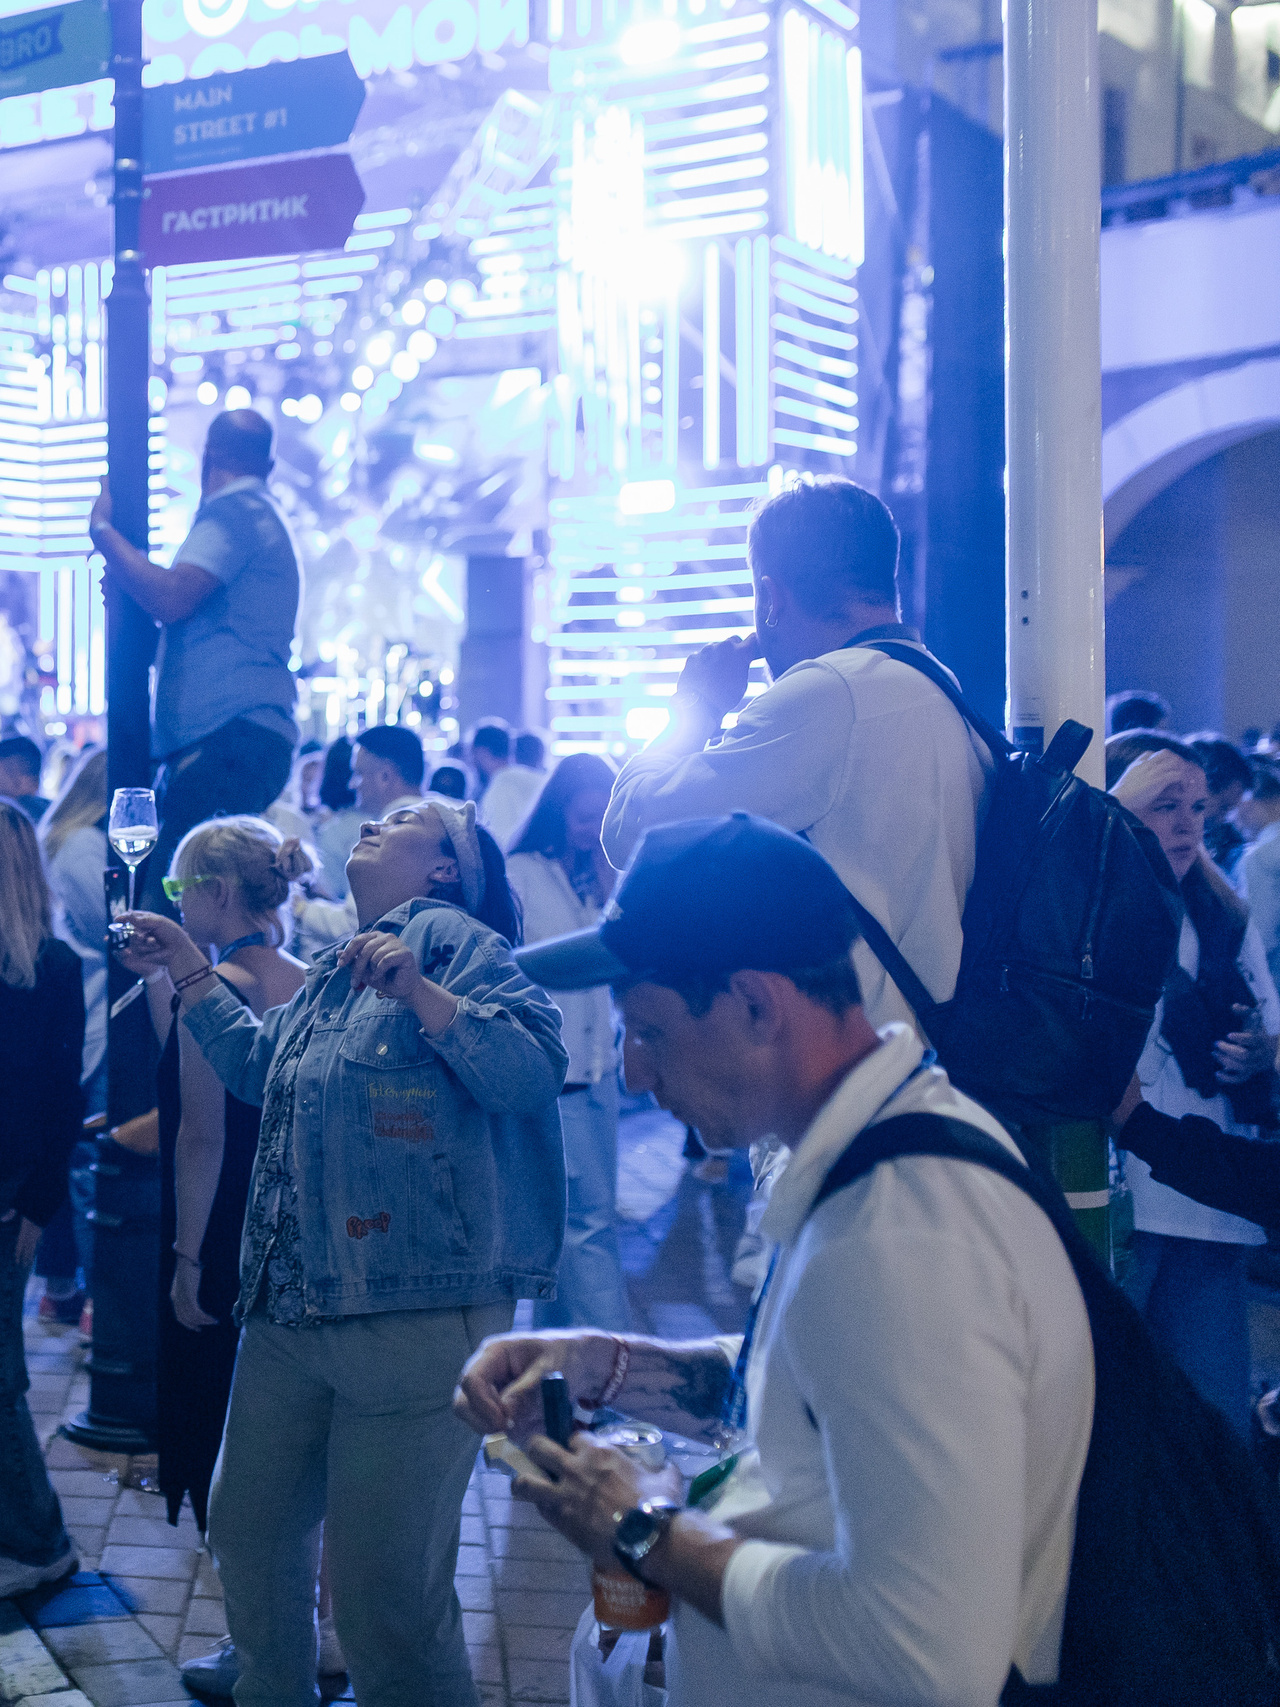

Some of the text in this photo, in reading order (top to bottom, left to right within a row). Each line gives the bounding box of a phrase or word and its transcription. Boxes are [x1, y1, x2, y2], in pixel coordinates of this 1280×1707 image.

[173, 85, 233, 112] MAIN
[173, 107, 288, 146] STREET #1
[161, 194, 310, 235] ГАСТРИТИК
